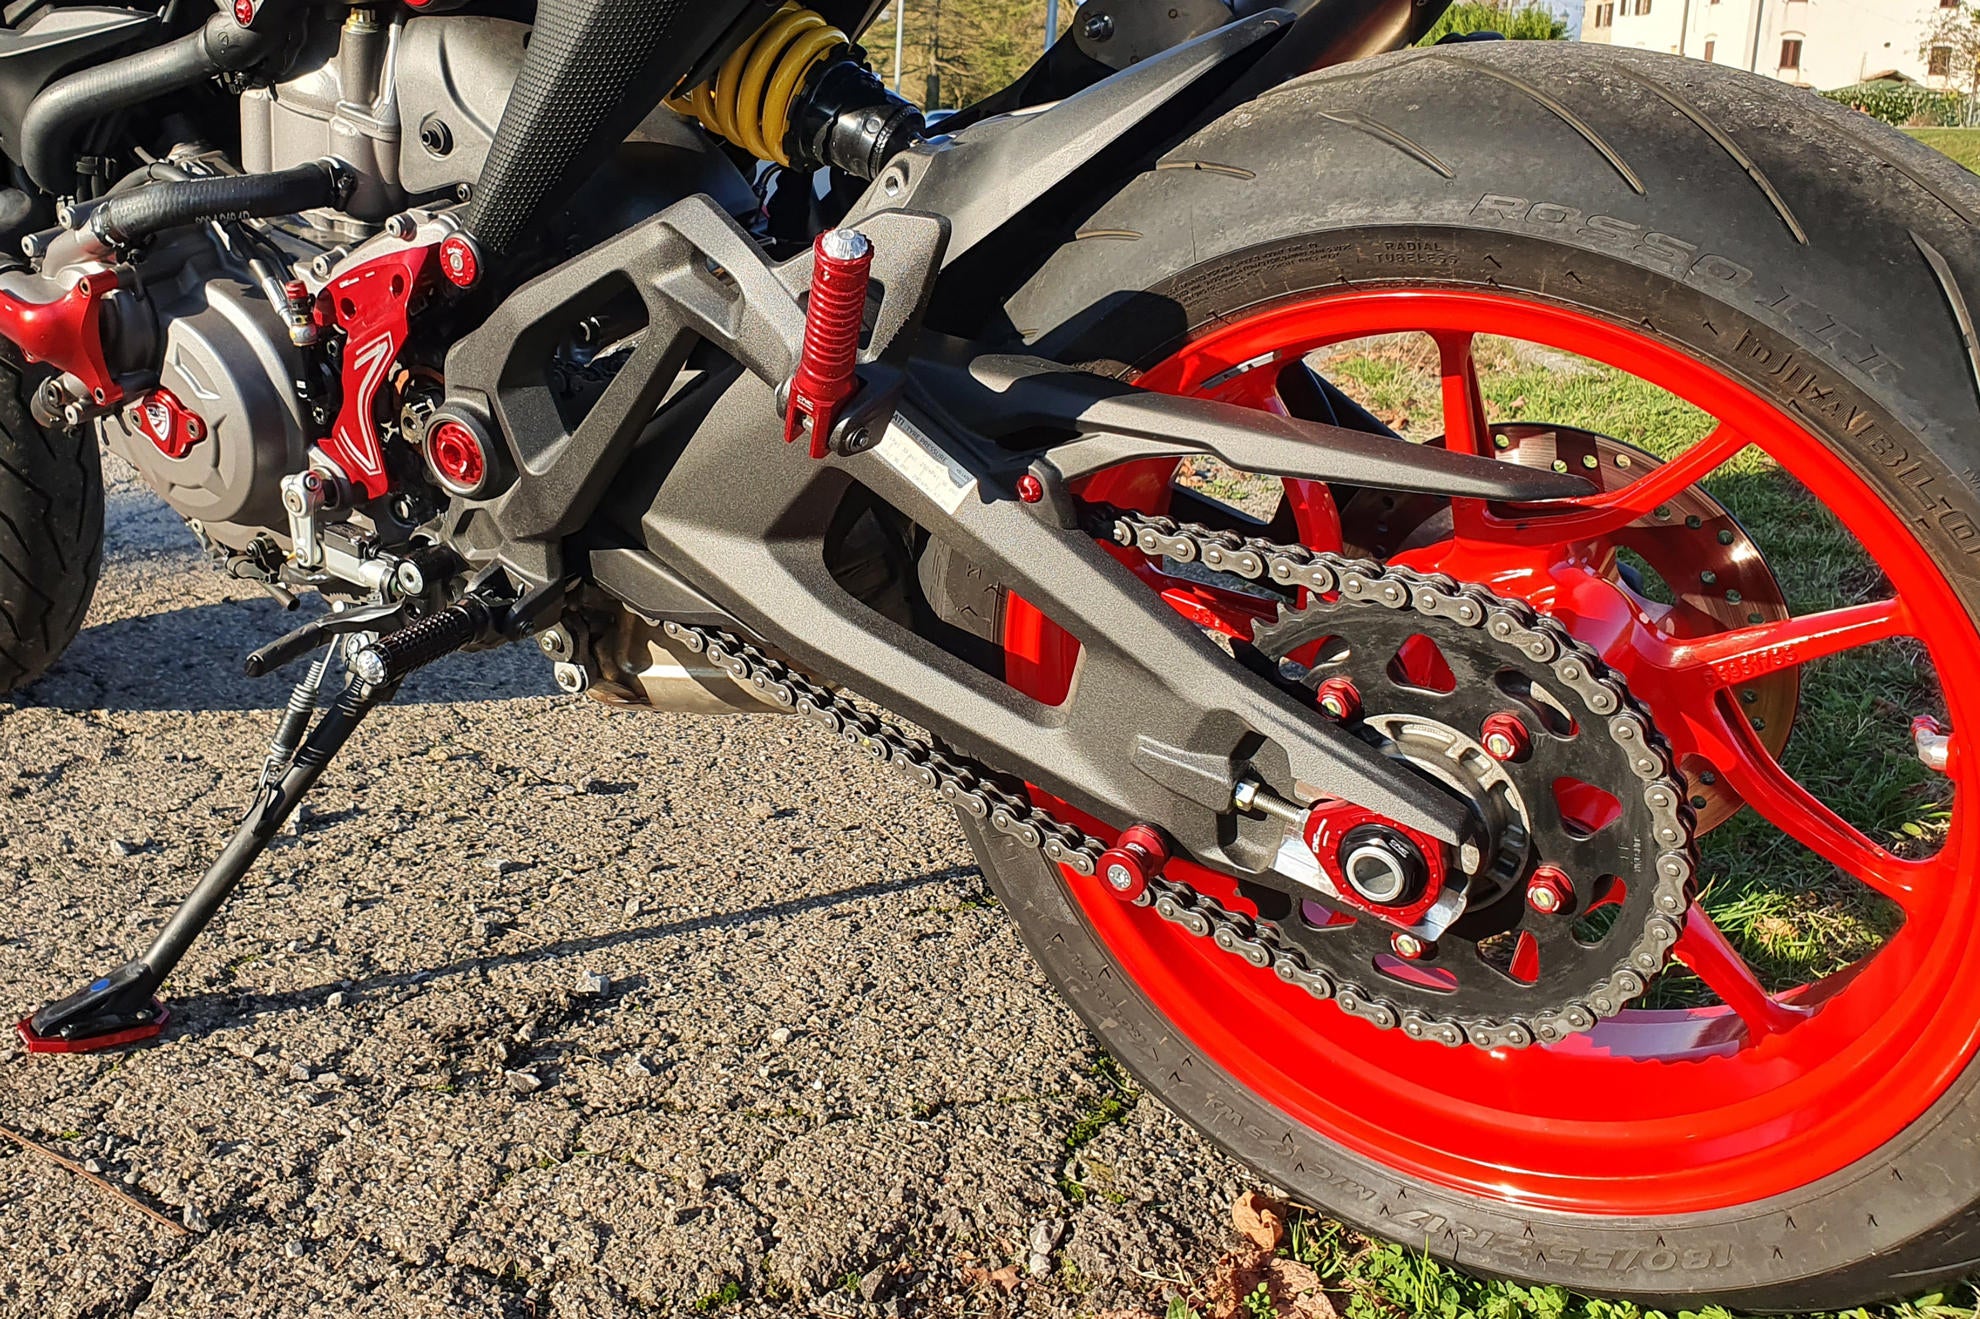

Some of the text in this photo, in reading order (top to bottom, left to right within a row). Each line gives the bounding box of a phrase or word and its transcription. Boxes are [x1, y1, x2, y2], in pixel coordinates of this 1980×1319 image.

[1384, 241, 1444, 252] RADIAL
[1468, 192, 1753, 288] ROSSO
[1374, 252, 1459, 265] TUBELESS
[906, 426, 920, 440] TYRE
[920, 438, 947, 462] PRESSURE
